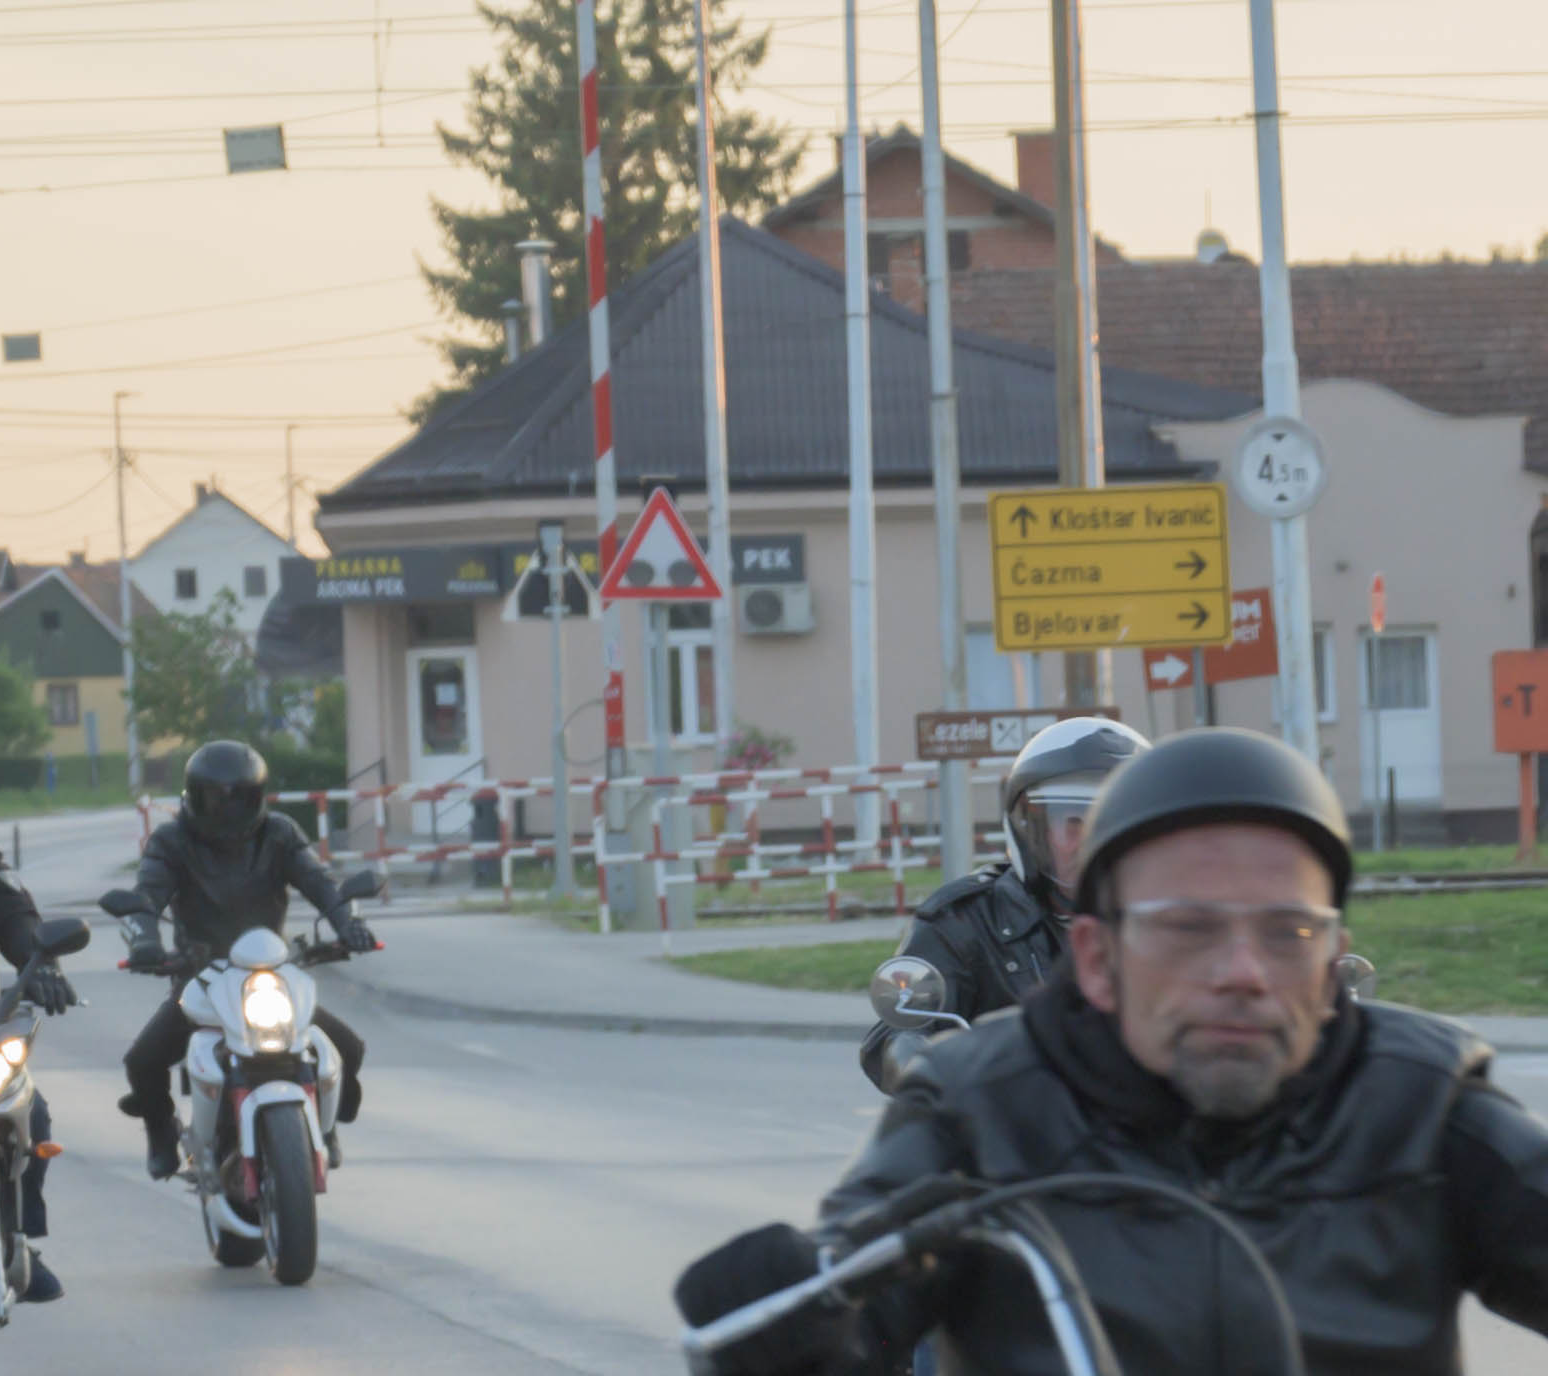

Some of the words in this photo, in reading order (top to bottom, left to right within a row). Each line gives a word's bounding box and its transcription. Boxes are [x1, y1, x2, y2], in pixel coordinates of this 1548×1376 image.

[1049, 504, 1135, 531] Kloštar
[742, 546, 793, 570] PEK
[1010, 557, 1102, 585] Čazma
[1013, 611, 1123, 640] Bjelovar
[1517, 684, 1538, 718] T
